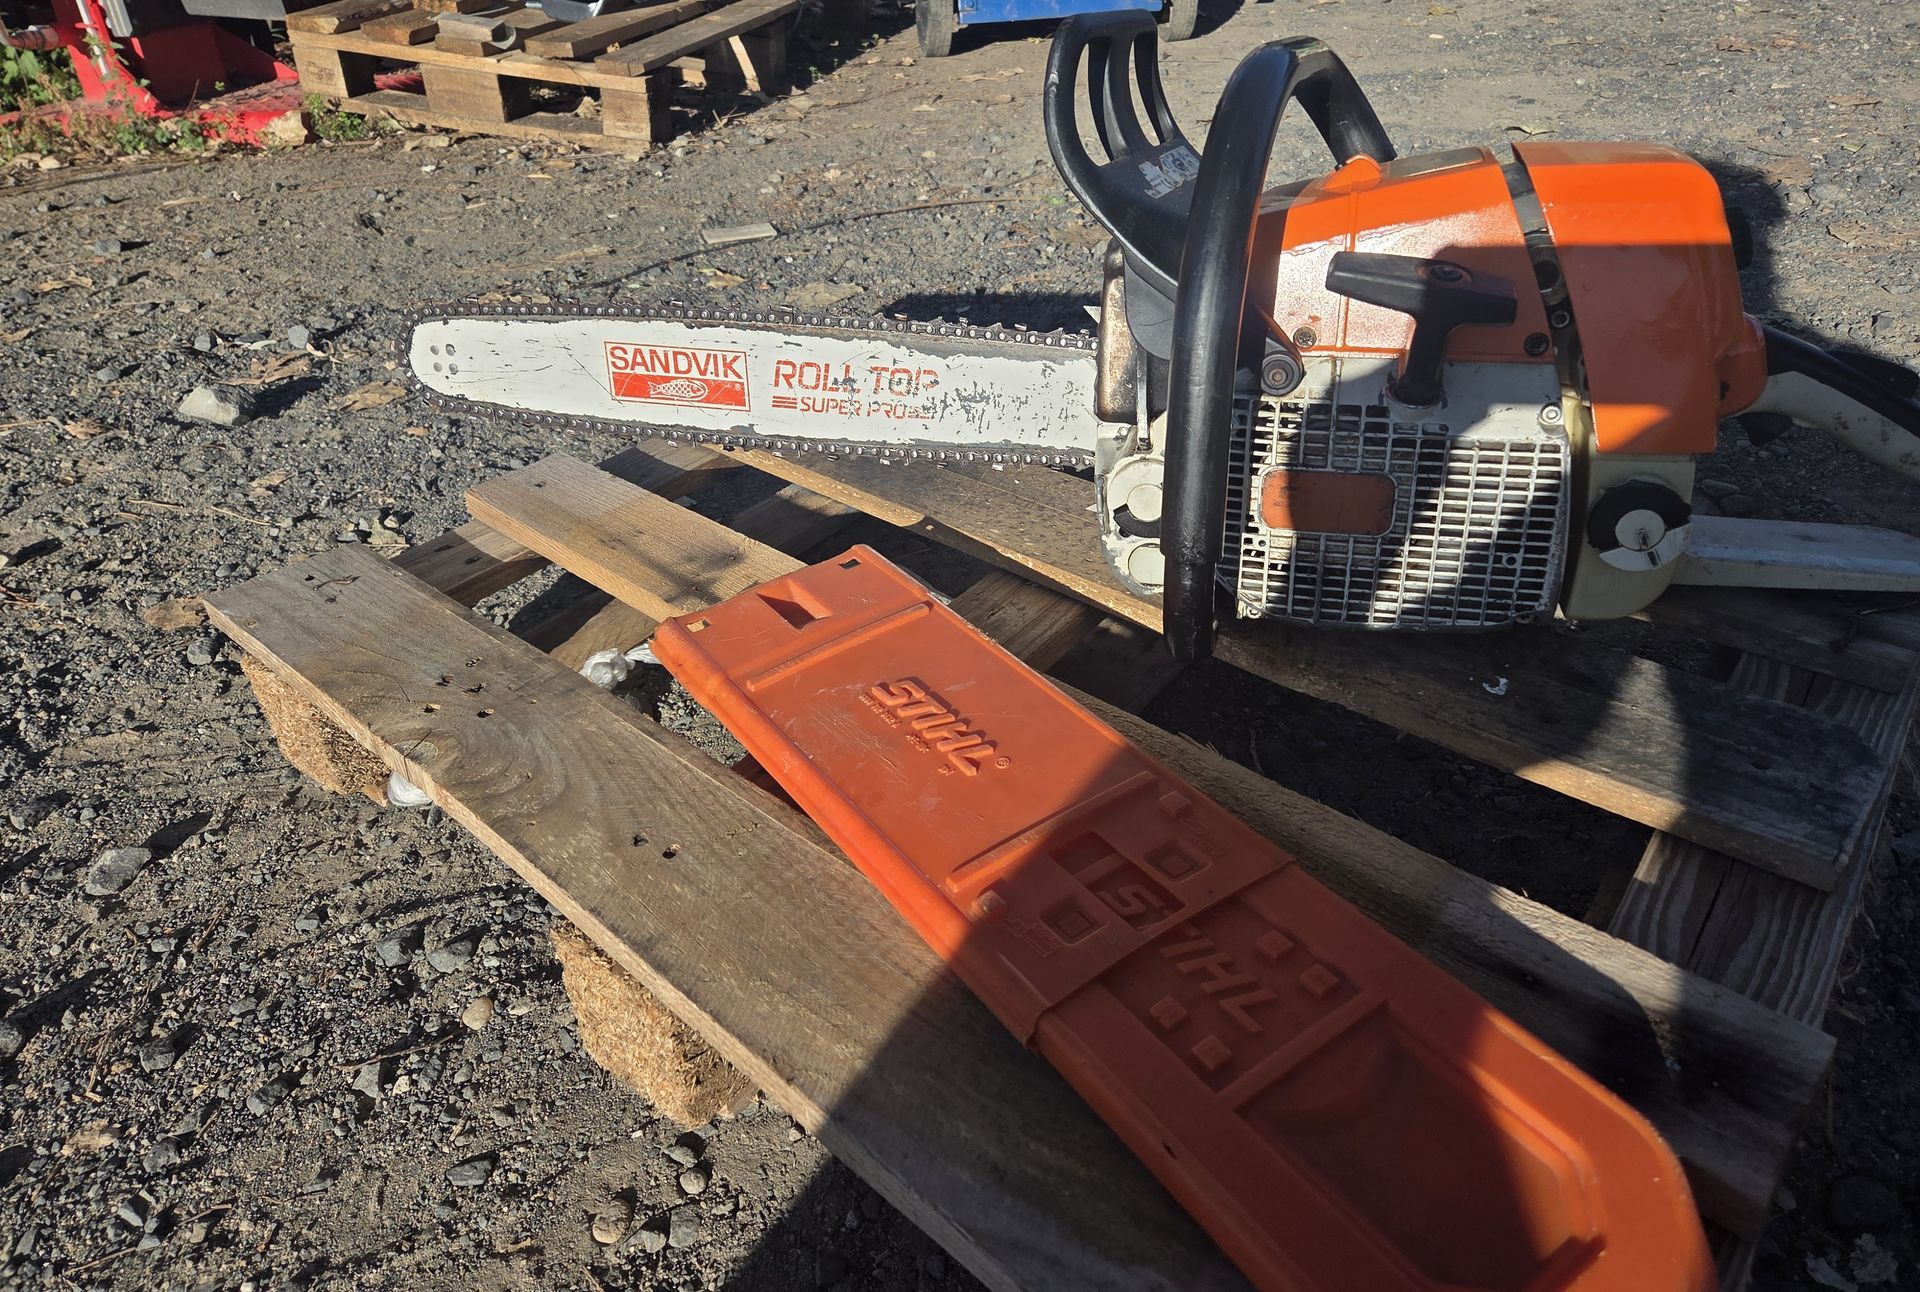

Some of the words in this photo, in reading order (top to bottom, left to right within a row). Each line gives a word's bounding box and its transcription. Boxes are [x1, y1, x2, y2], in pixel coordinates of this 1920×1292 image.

[609, 345, 744, 380] SANDVIK
[773, 359, 862, 395] ROLL
[869, 366, 940, 398] TOP
[800, 396, 862, 417] SUPER
[871, 679, 995, 777] STIHL
